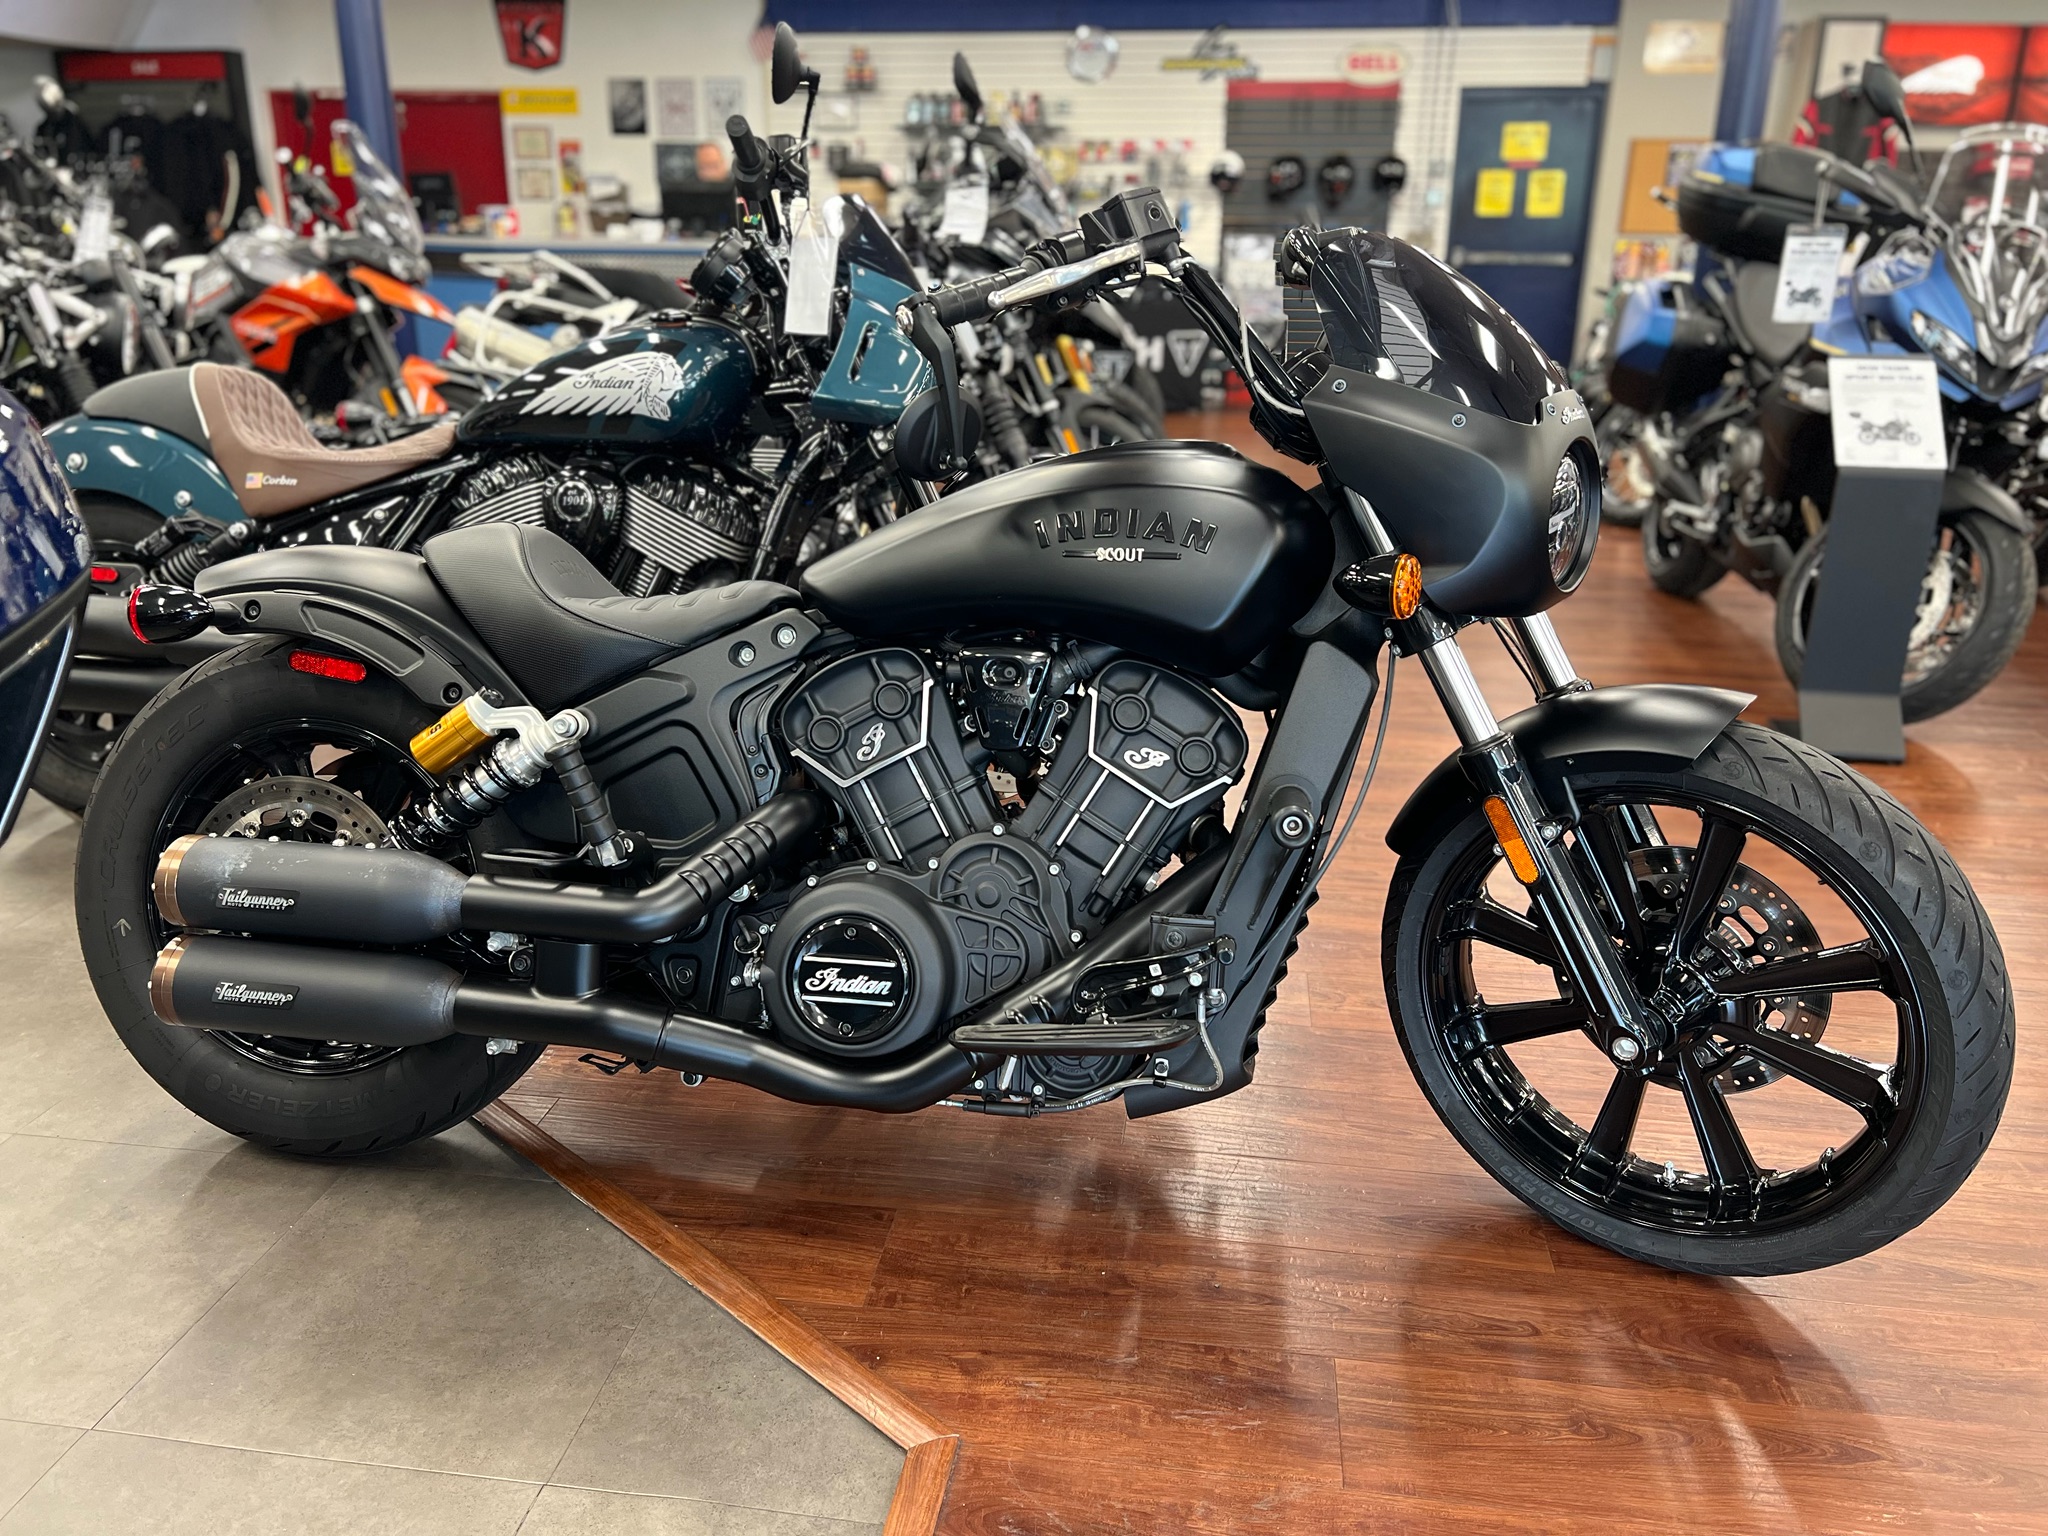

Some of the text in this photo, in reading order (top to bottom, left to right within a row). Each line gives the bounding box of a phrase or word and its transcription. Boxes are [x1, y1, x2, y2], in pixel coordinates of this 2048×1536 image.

[572, 371, 635, 390] Indian
[262, 474, 298, 486] Corbin
[562, 495, 585, 506] 1901
[1033, 507, 1219, 554] INDIAN
[1095, 547, 1145, 562] SCOUT
[220, 887, 290, 908] Tailgunner
[804, 967, 893, 995] Indian
[217, 981, 288, 1003] Tailgunner
[226, 1084, 377, 1117] METZELER
